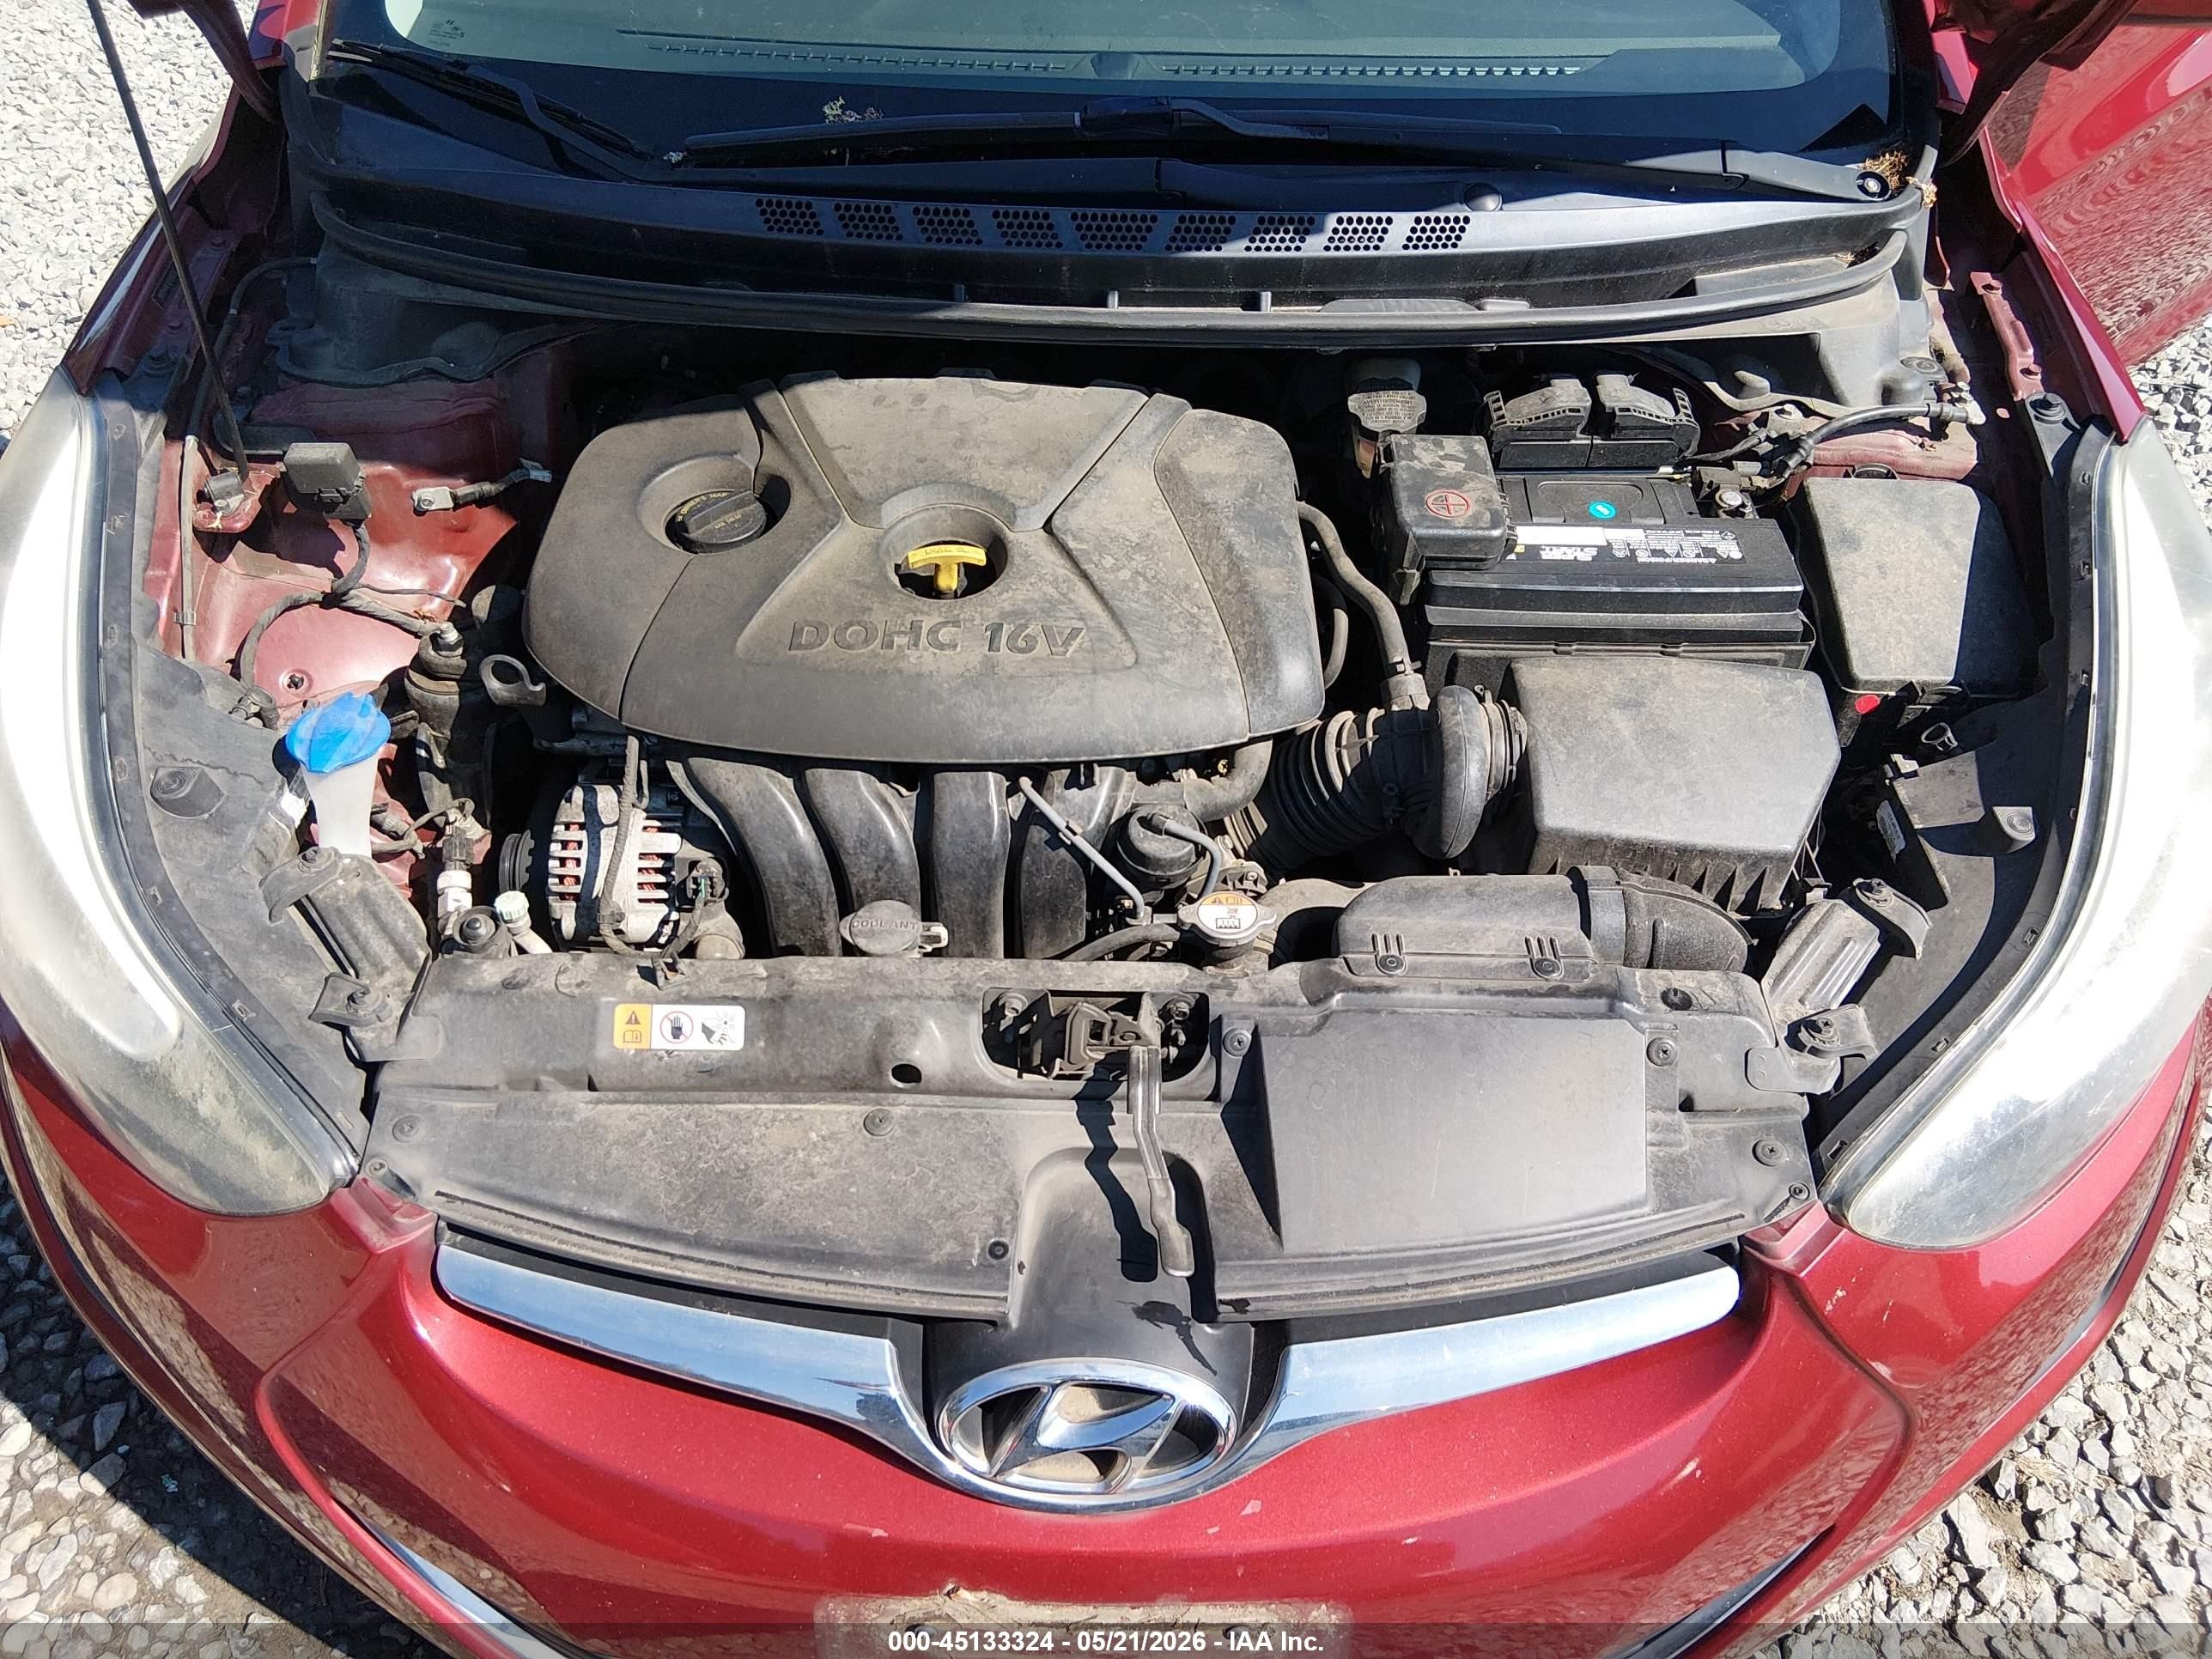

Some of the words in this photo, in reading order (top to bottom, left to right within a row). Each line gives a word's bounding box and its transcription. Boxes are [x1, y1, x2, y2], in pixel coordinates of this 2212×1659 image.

[788, 619, 963, 652] DOHC
[984, 622, 1085, 657] 16V
[851, 920, 919, 930] COOLANT
